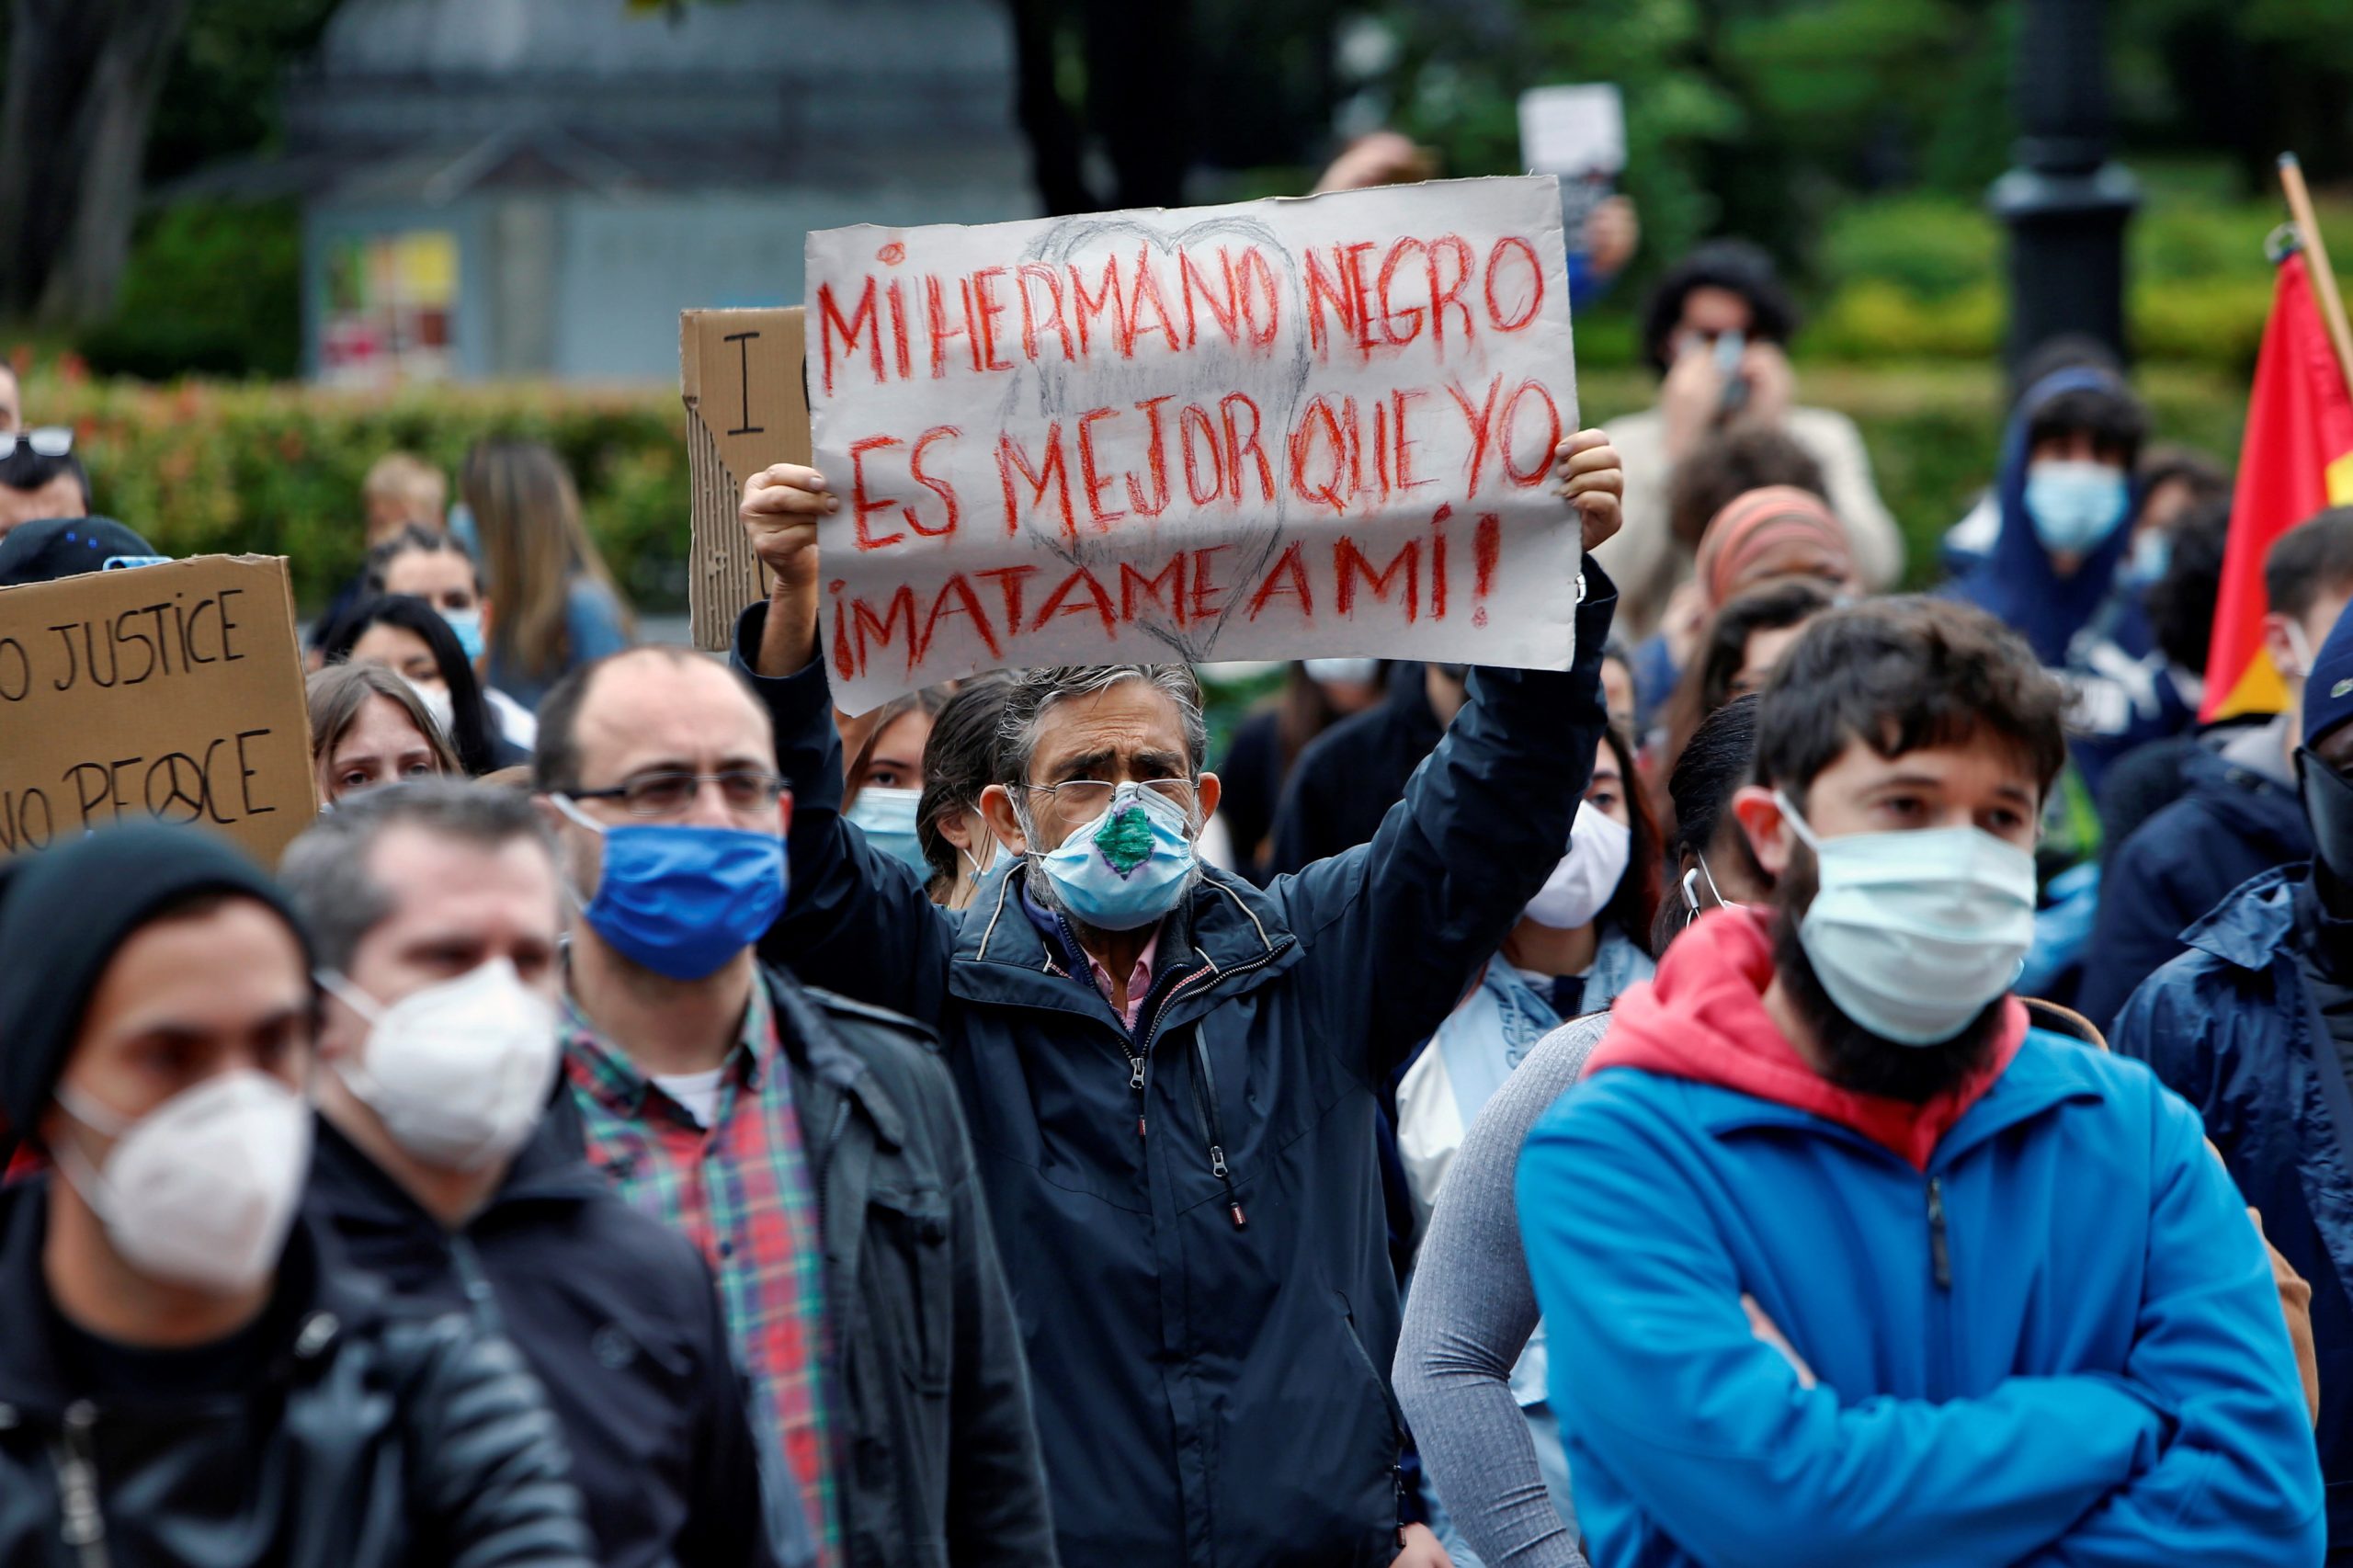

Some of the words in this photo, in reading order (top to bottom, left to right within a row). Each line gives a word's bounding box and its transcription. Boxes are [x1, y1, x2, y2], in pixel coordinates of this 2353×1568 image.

[926, 241, 1281, 379] HERMANO
[1302, 233, 1546, 363] NEGRO
[723, 332, 764, 435] I
[848, 425, 961, 551] ES
[996, 391, 1276, 537] MEJOR
[1288, 388, 1439, 517] QUE
[1444, 372, 1563, 500] YO
[1243, 540, 1314, 622] A
[0, 638, 30, 701] O
